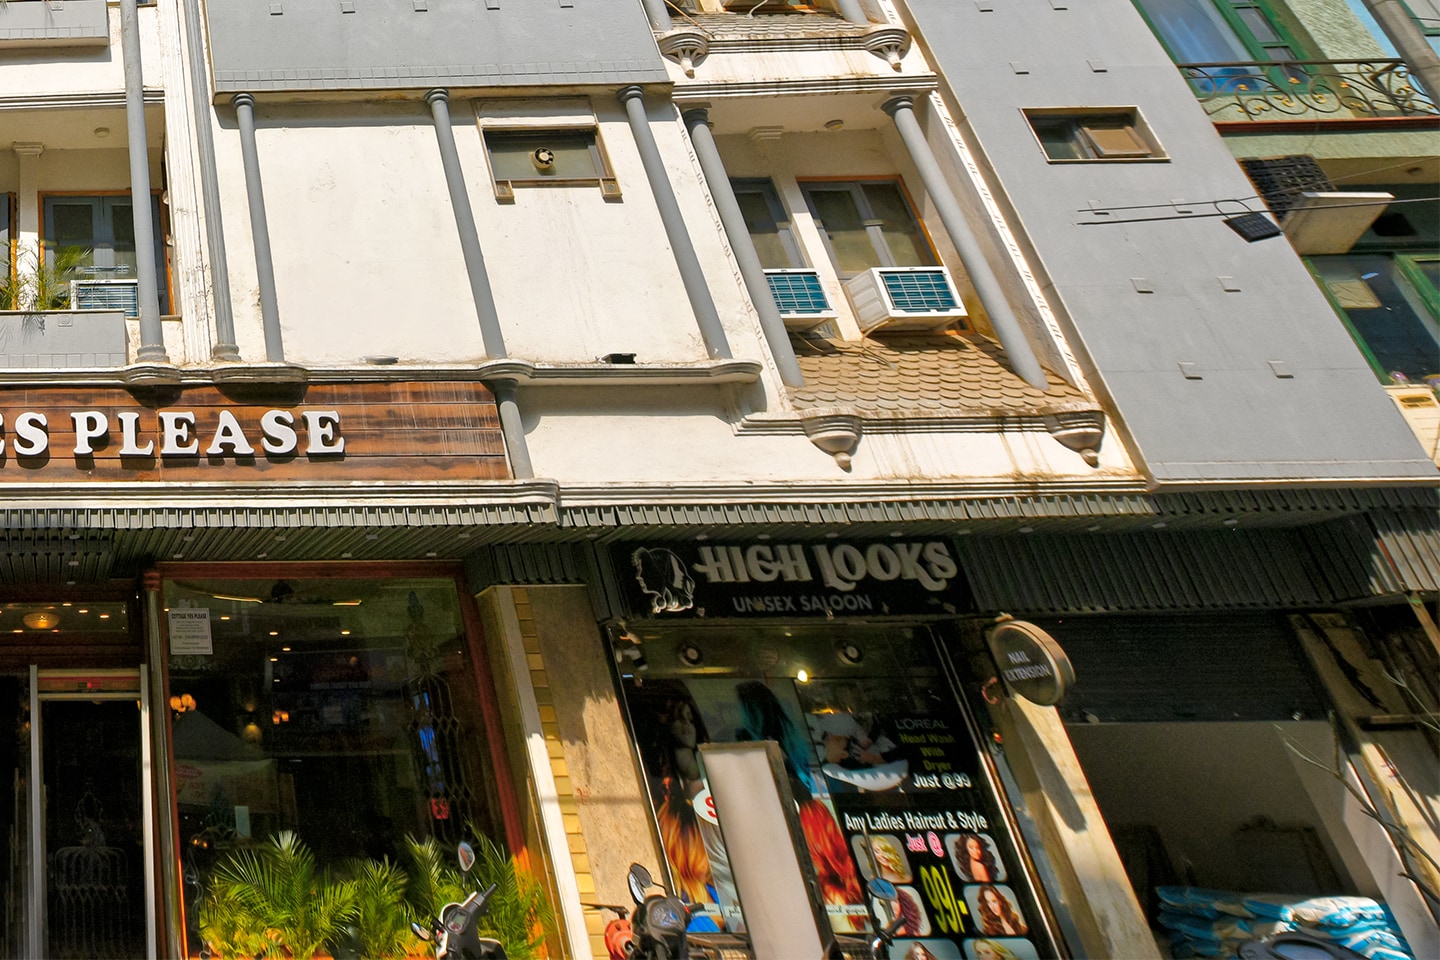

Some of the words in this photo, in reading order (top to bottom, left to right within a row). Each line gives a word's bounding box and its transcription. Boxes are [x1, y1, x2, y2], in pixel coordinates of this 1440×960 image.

[70, 410, 346, 456] PLEASE
[693, 544, 813, 583] HIGH
[812, 542, 958, 591] LOOKS
[799, 594, 872, 611] SALOON
[1007, 650, 1031, 665] NAIL
[1003, 664, 1052, 682] EXTENSION
[899, 733, 927, 744] Head
[926, 733, 956, 744] Wash
[920, 747, 945, 758] With
[923, 760, 952, 773] Dryer
[913, 773, 941, 788] Just
[940, 773, 972, 790] @99
[844, 812, 866, 831] Any
[865, 811, 906, 831] Ladies
[903, 811, 948, 831] Haircut
[945, 810, 959, 829] &
[957, 810, 988, 833] Style
[905, 832, 928, 852] Just
[920, 864, 969, 934] 99/-
